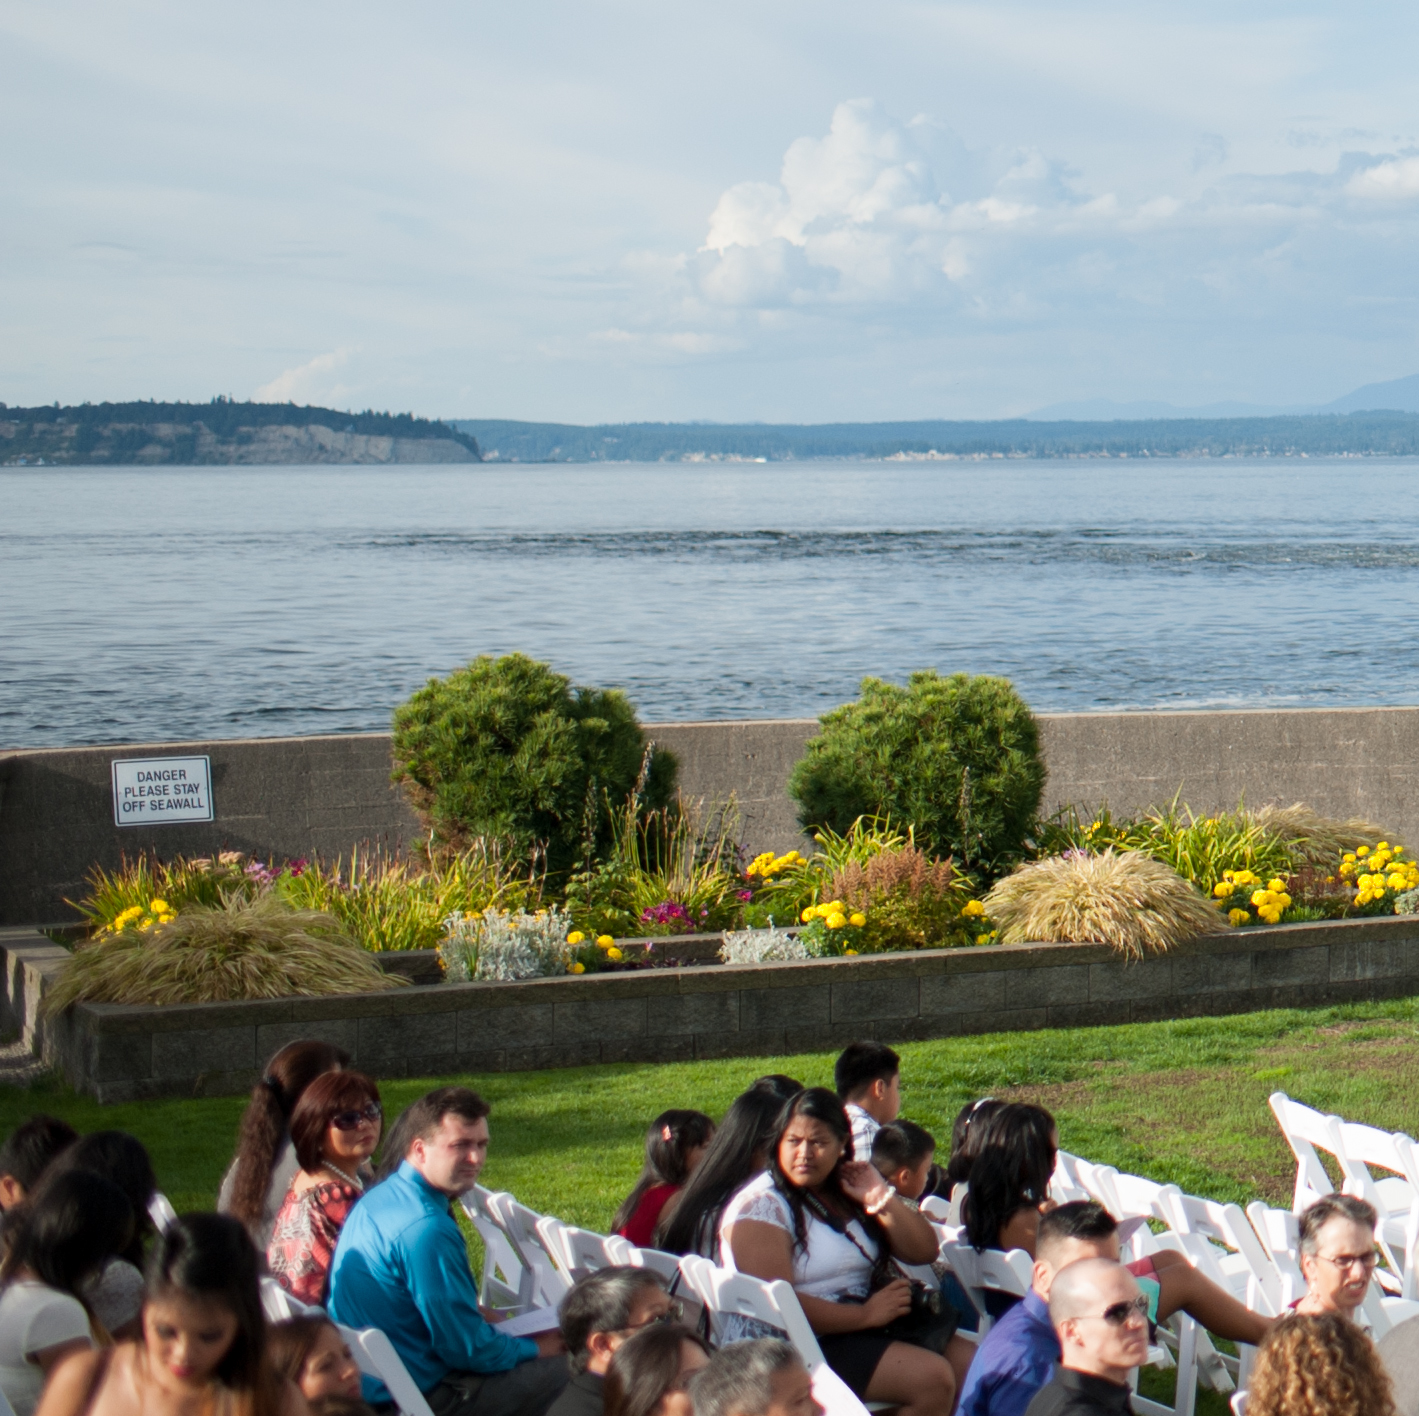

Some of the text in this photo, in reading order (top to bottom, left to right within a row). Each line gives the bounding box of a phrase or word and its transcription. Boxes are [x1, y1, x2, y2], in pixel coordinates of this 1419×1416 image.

[137, 769, 187, 783] DANGER
[124, 783, 200, 798] PLEASE STAY
[122, 797, 204, 813] OFF SEAWALL
